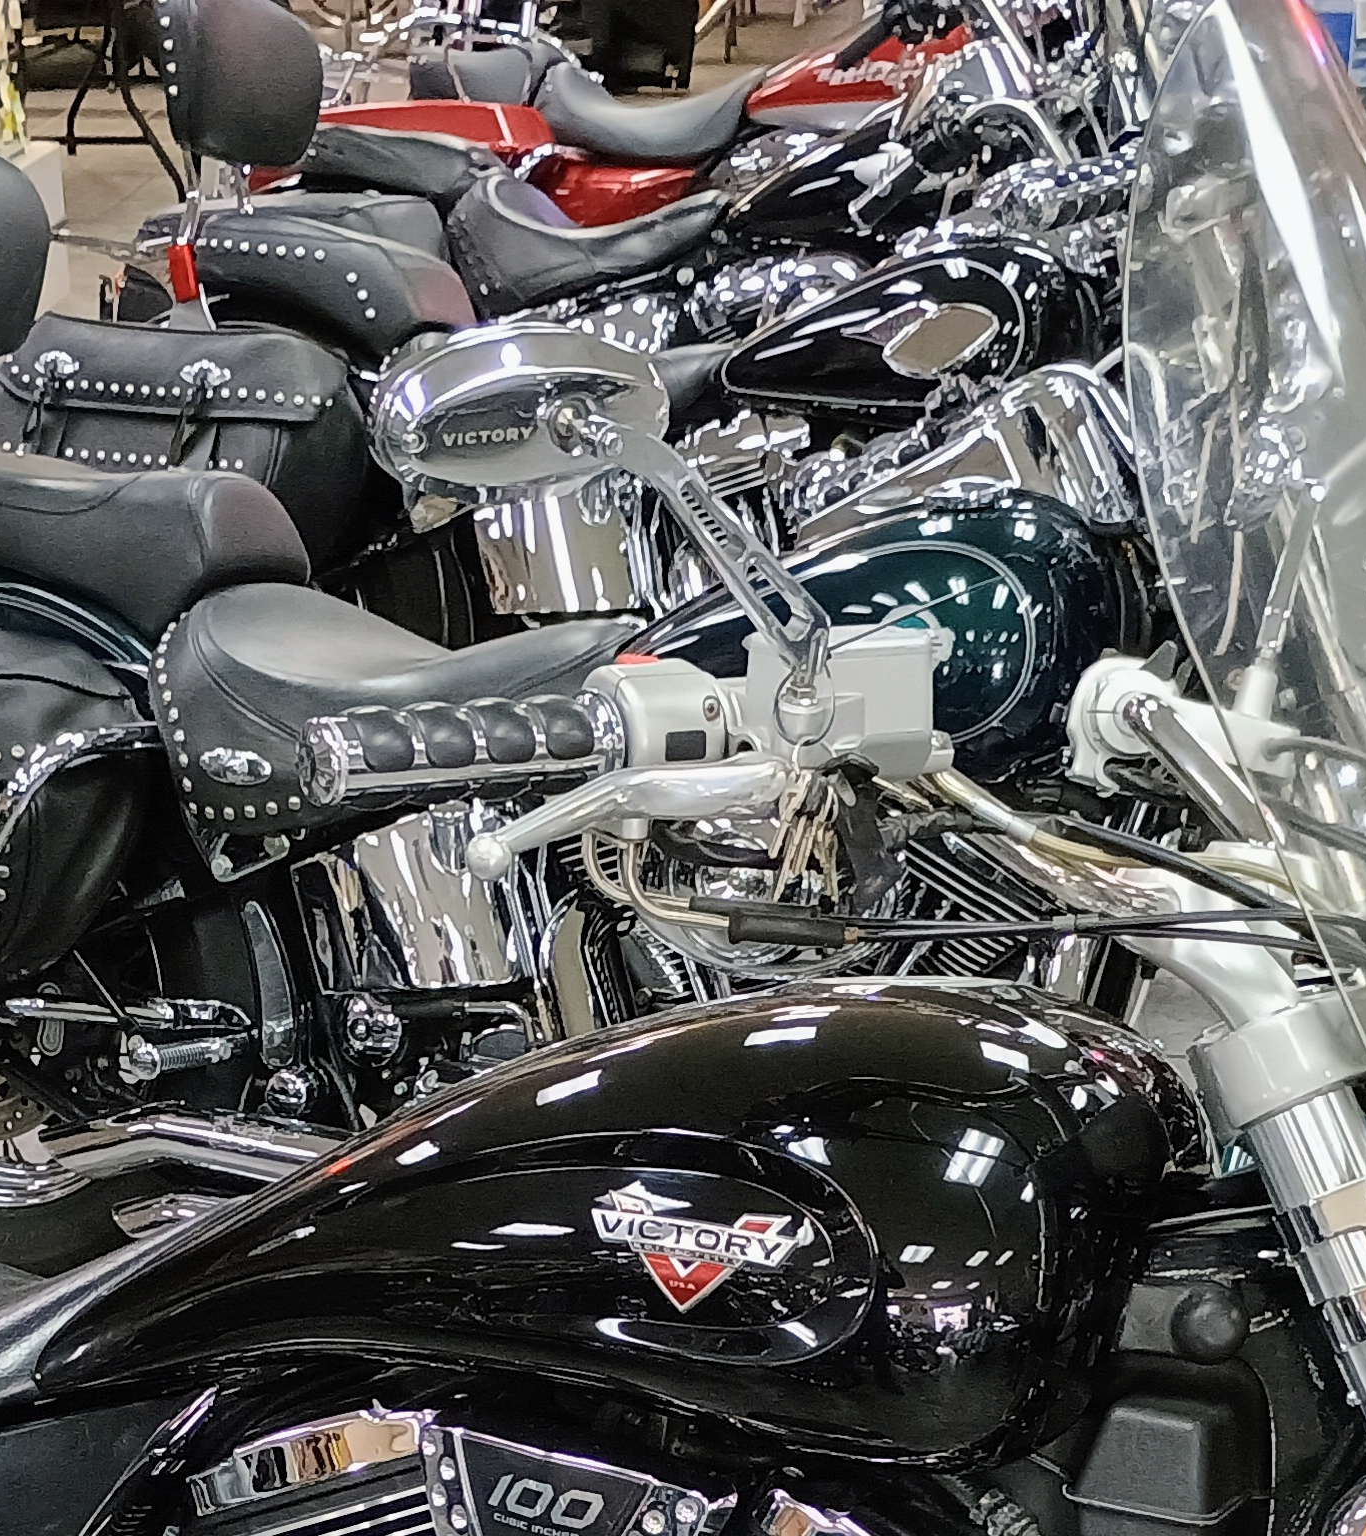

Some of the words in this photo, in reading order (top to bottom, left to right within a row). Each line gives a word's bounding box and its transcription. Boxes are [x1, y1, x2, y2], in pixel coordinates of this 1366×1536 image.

[441, 425, 534, 447] VICTORY
[600, 1212, 785, 1261] VICTORY
[487, 1473, 605, 1530] 100
[493, 1512, 529, 1531] CUBIC
